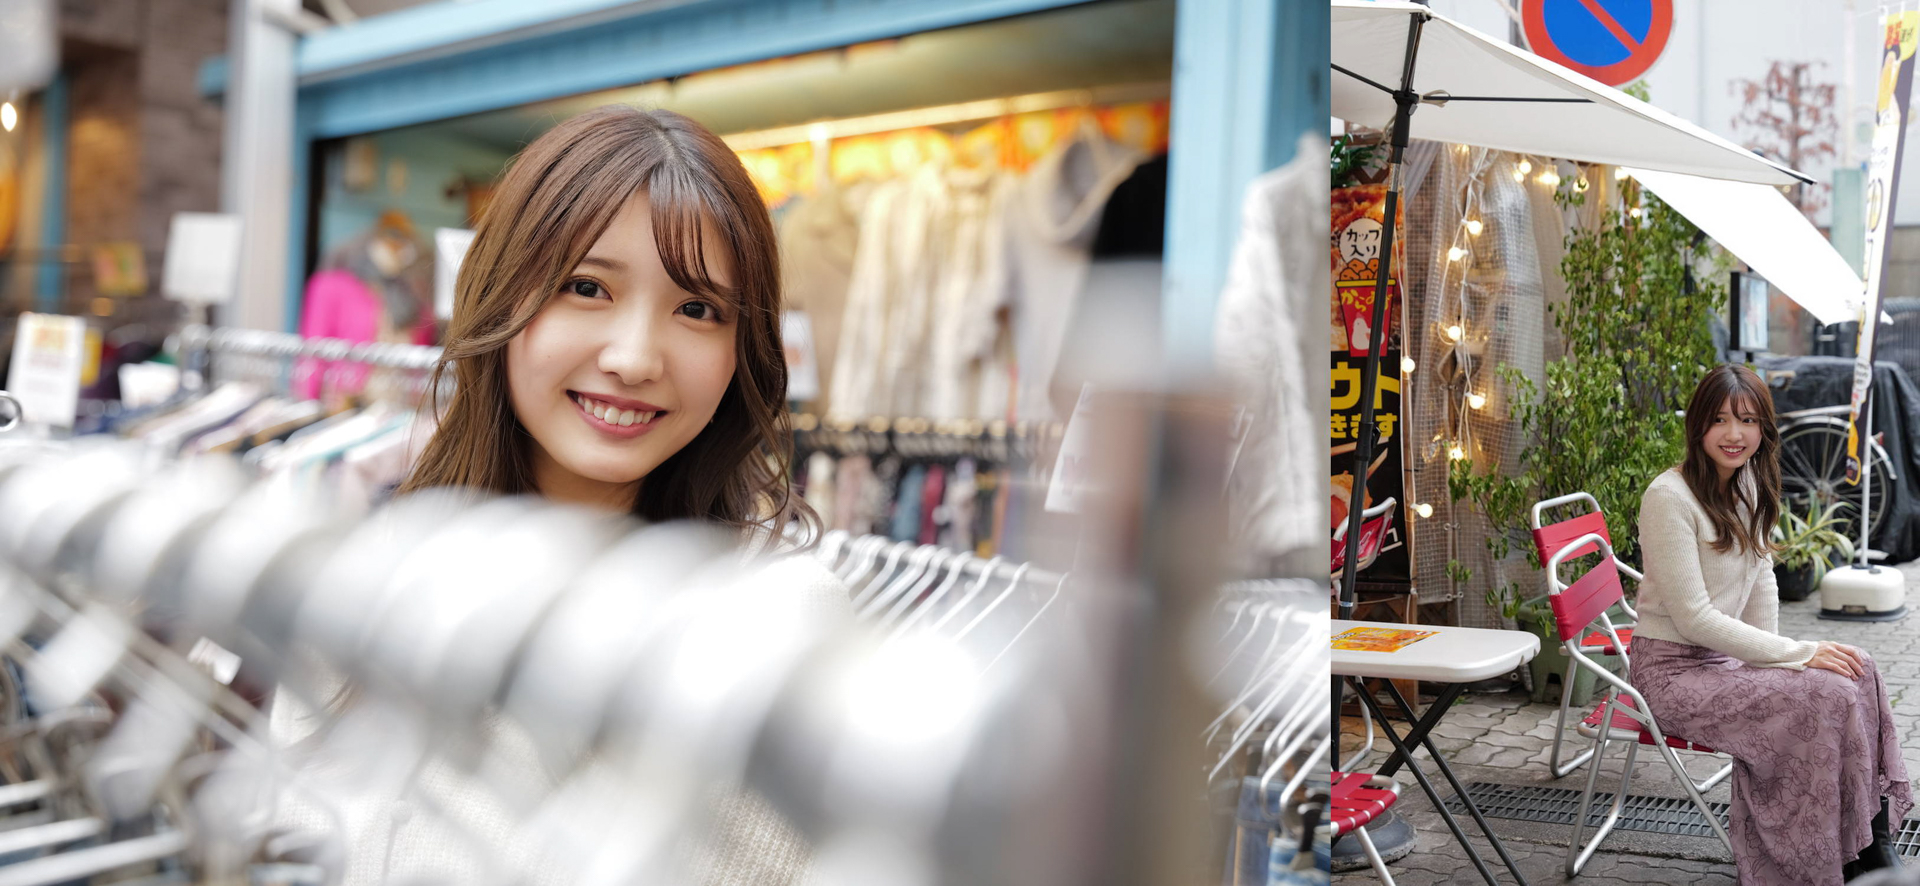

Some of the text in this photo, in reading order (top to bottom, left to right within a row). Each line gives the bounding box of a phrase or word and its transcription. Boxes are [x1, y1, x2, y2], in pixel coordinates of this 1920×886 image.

[1346, 226, 1383, 243] カップ
[1350, 244, 1377, 257] 入り
[1341, 289, 1393, 312] から
